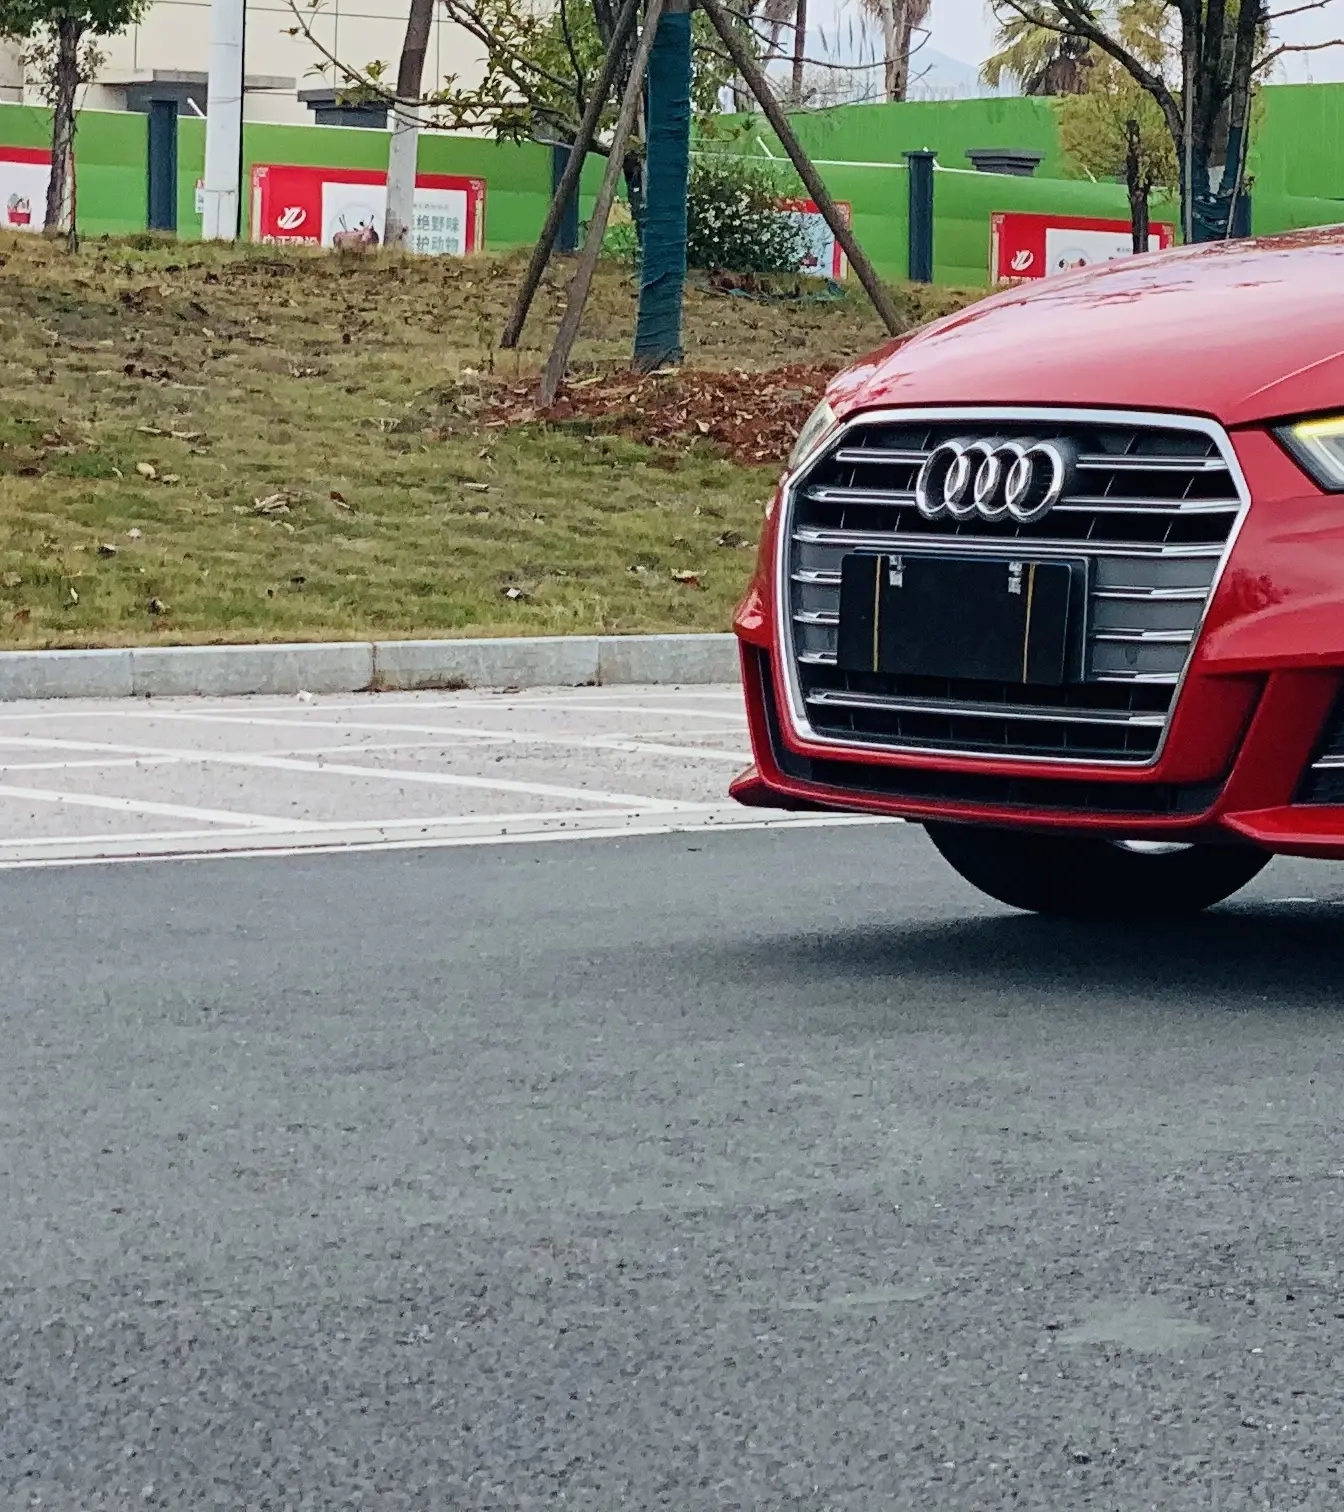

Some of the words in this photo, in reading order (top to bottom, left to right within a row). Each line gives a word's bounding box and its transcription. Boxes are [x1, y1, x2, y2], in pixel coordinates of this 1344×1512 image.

[412, 214, 459, 233] 绝野味
[411, 234, 459, 254] 护动物
